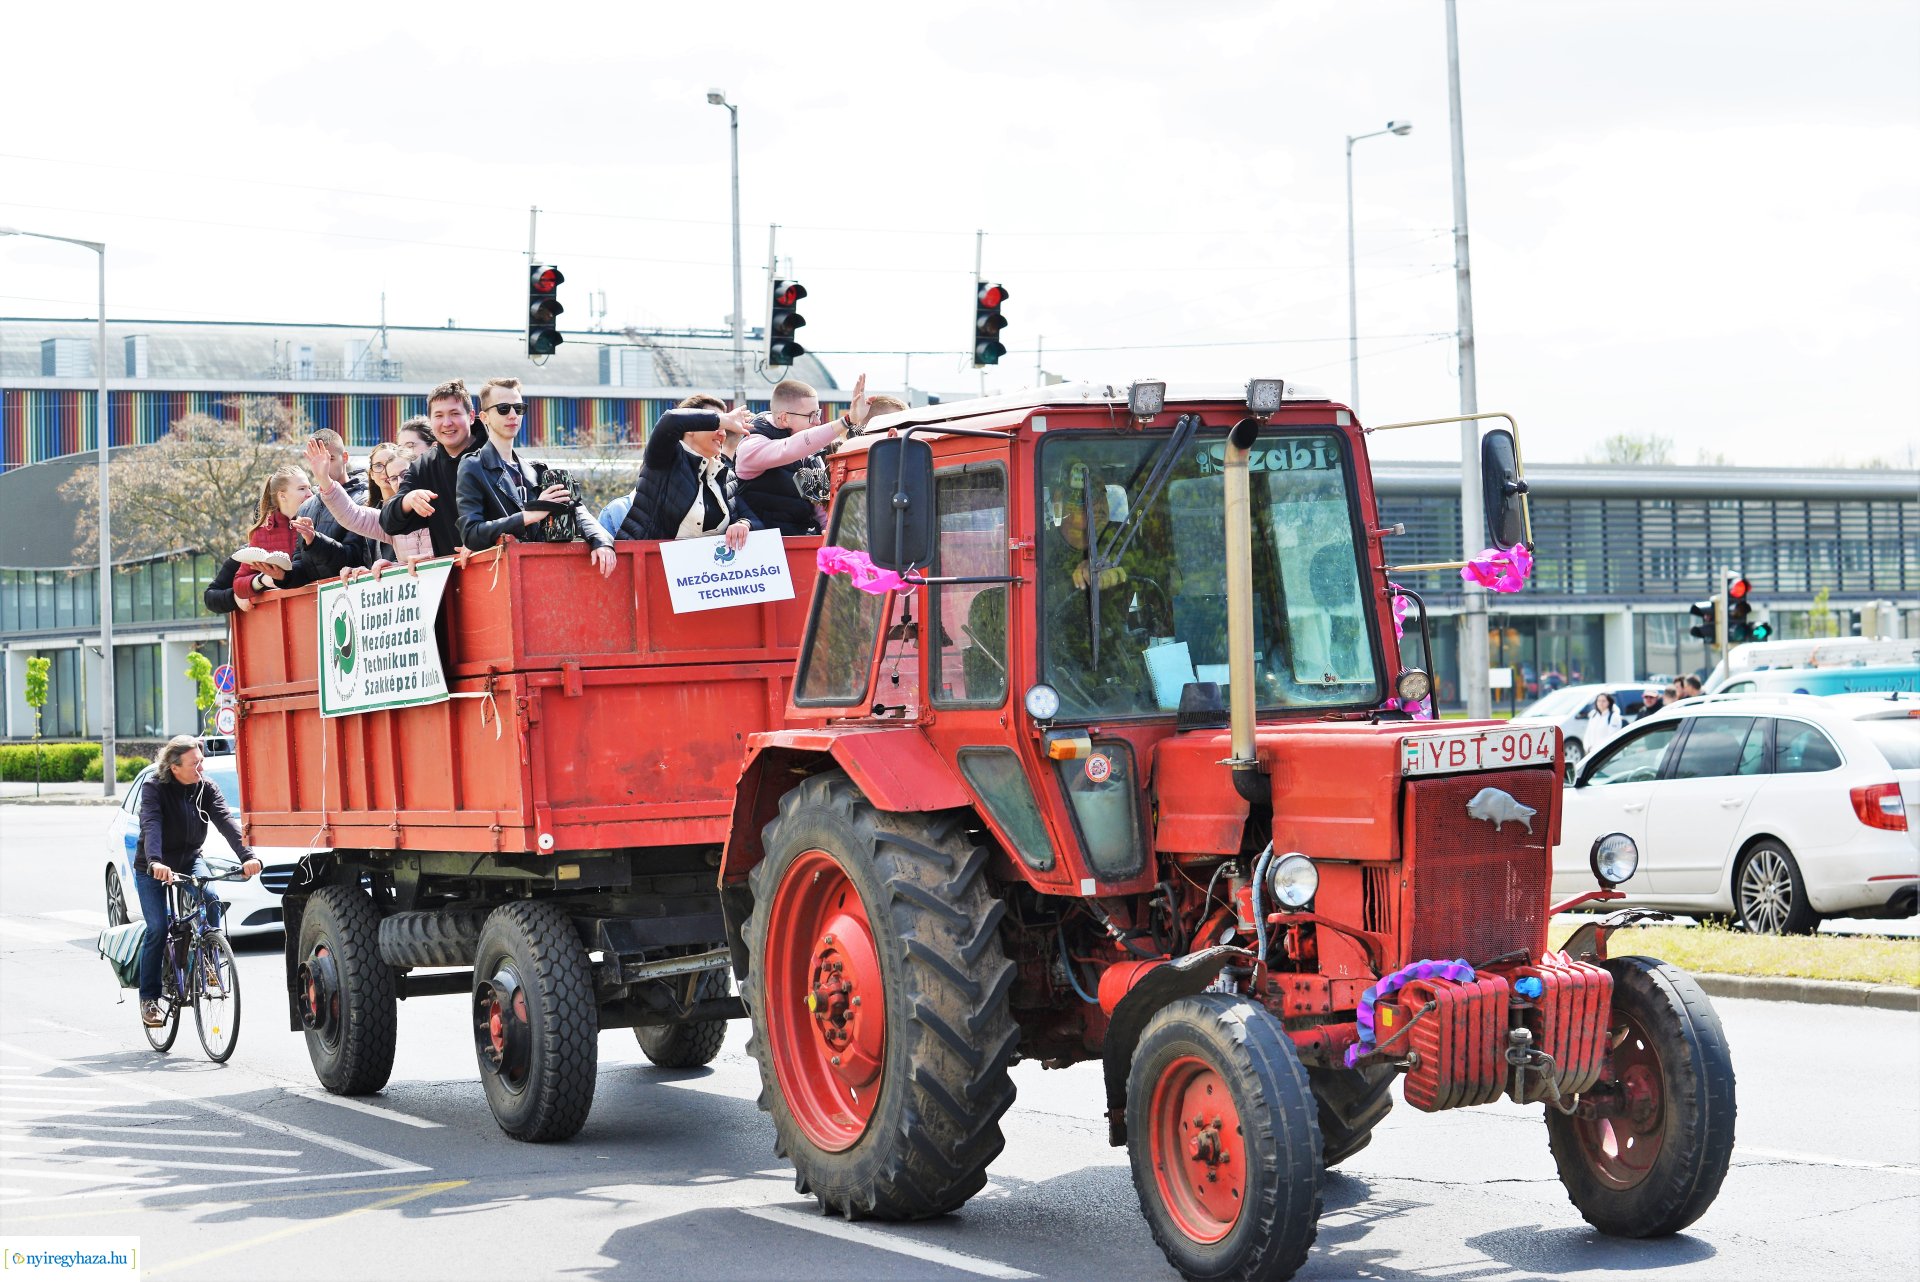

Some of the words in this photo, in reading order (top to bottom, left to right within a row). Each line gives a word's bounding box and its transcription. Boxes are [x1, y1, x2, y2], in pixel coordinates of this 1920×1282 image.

[1210, 440, 1328, 473] Szabi
[677, 564, 781, 587] MEZŐGAZDASÁGI
[361, 586, 394, 609] Északi
[398, 581, 420, 602] ASz
[698, 583, 766, 600] TECHNIKUS
[361, 608, 392, 631] Lippai
[363, 651, 419, 674] Technikum
[364, 671, 417, 696] Szakképző
[1429, 731, 1550, 769] YBT-904
[1407, 757, 1419, 771] H
